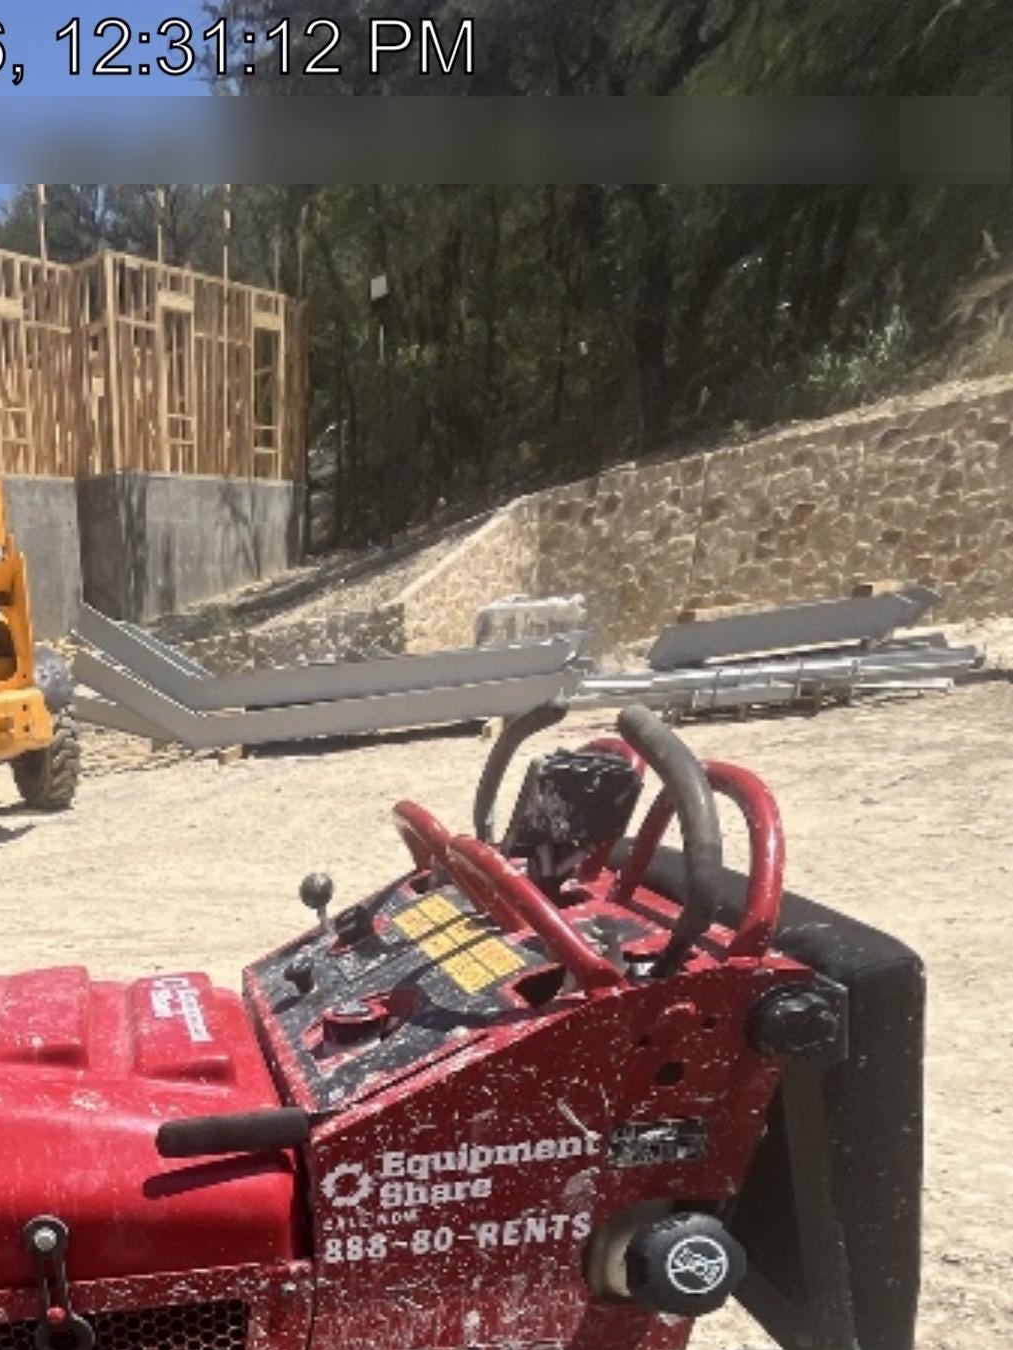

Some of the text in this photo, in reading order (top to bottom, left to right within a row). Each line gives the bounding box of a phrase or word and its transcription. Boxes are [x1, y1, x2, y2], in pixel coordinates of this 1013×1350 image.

[378, 1135, 601, 1180] Equipment
[379, 1177, 492, 1210] Share
[323, 1211, 591, 1264] 888-80-RENTS
